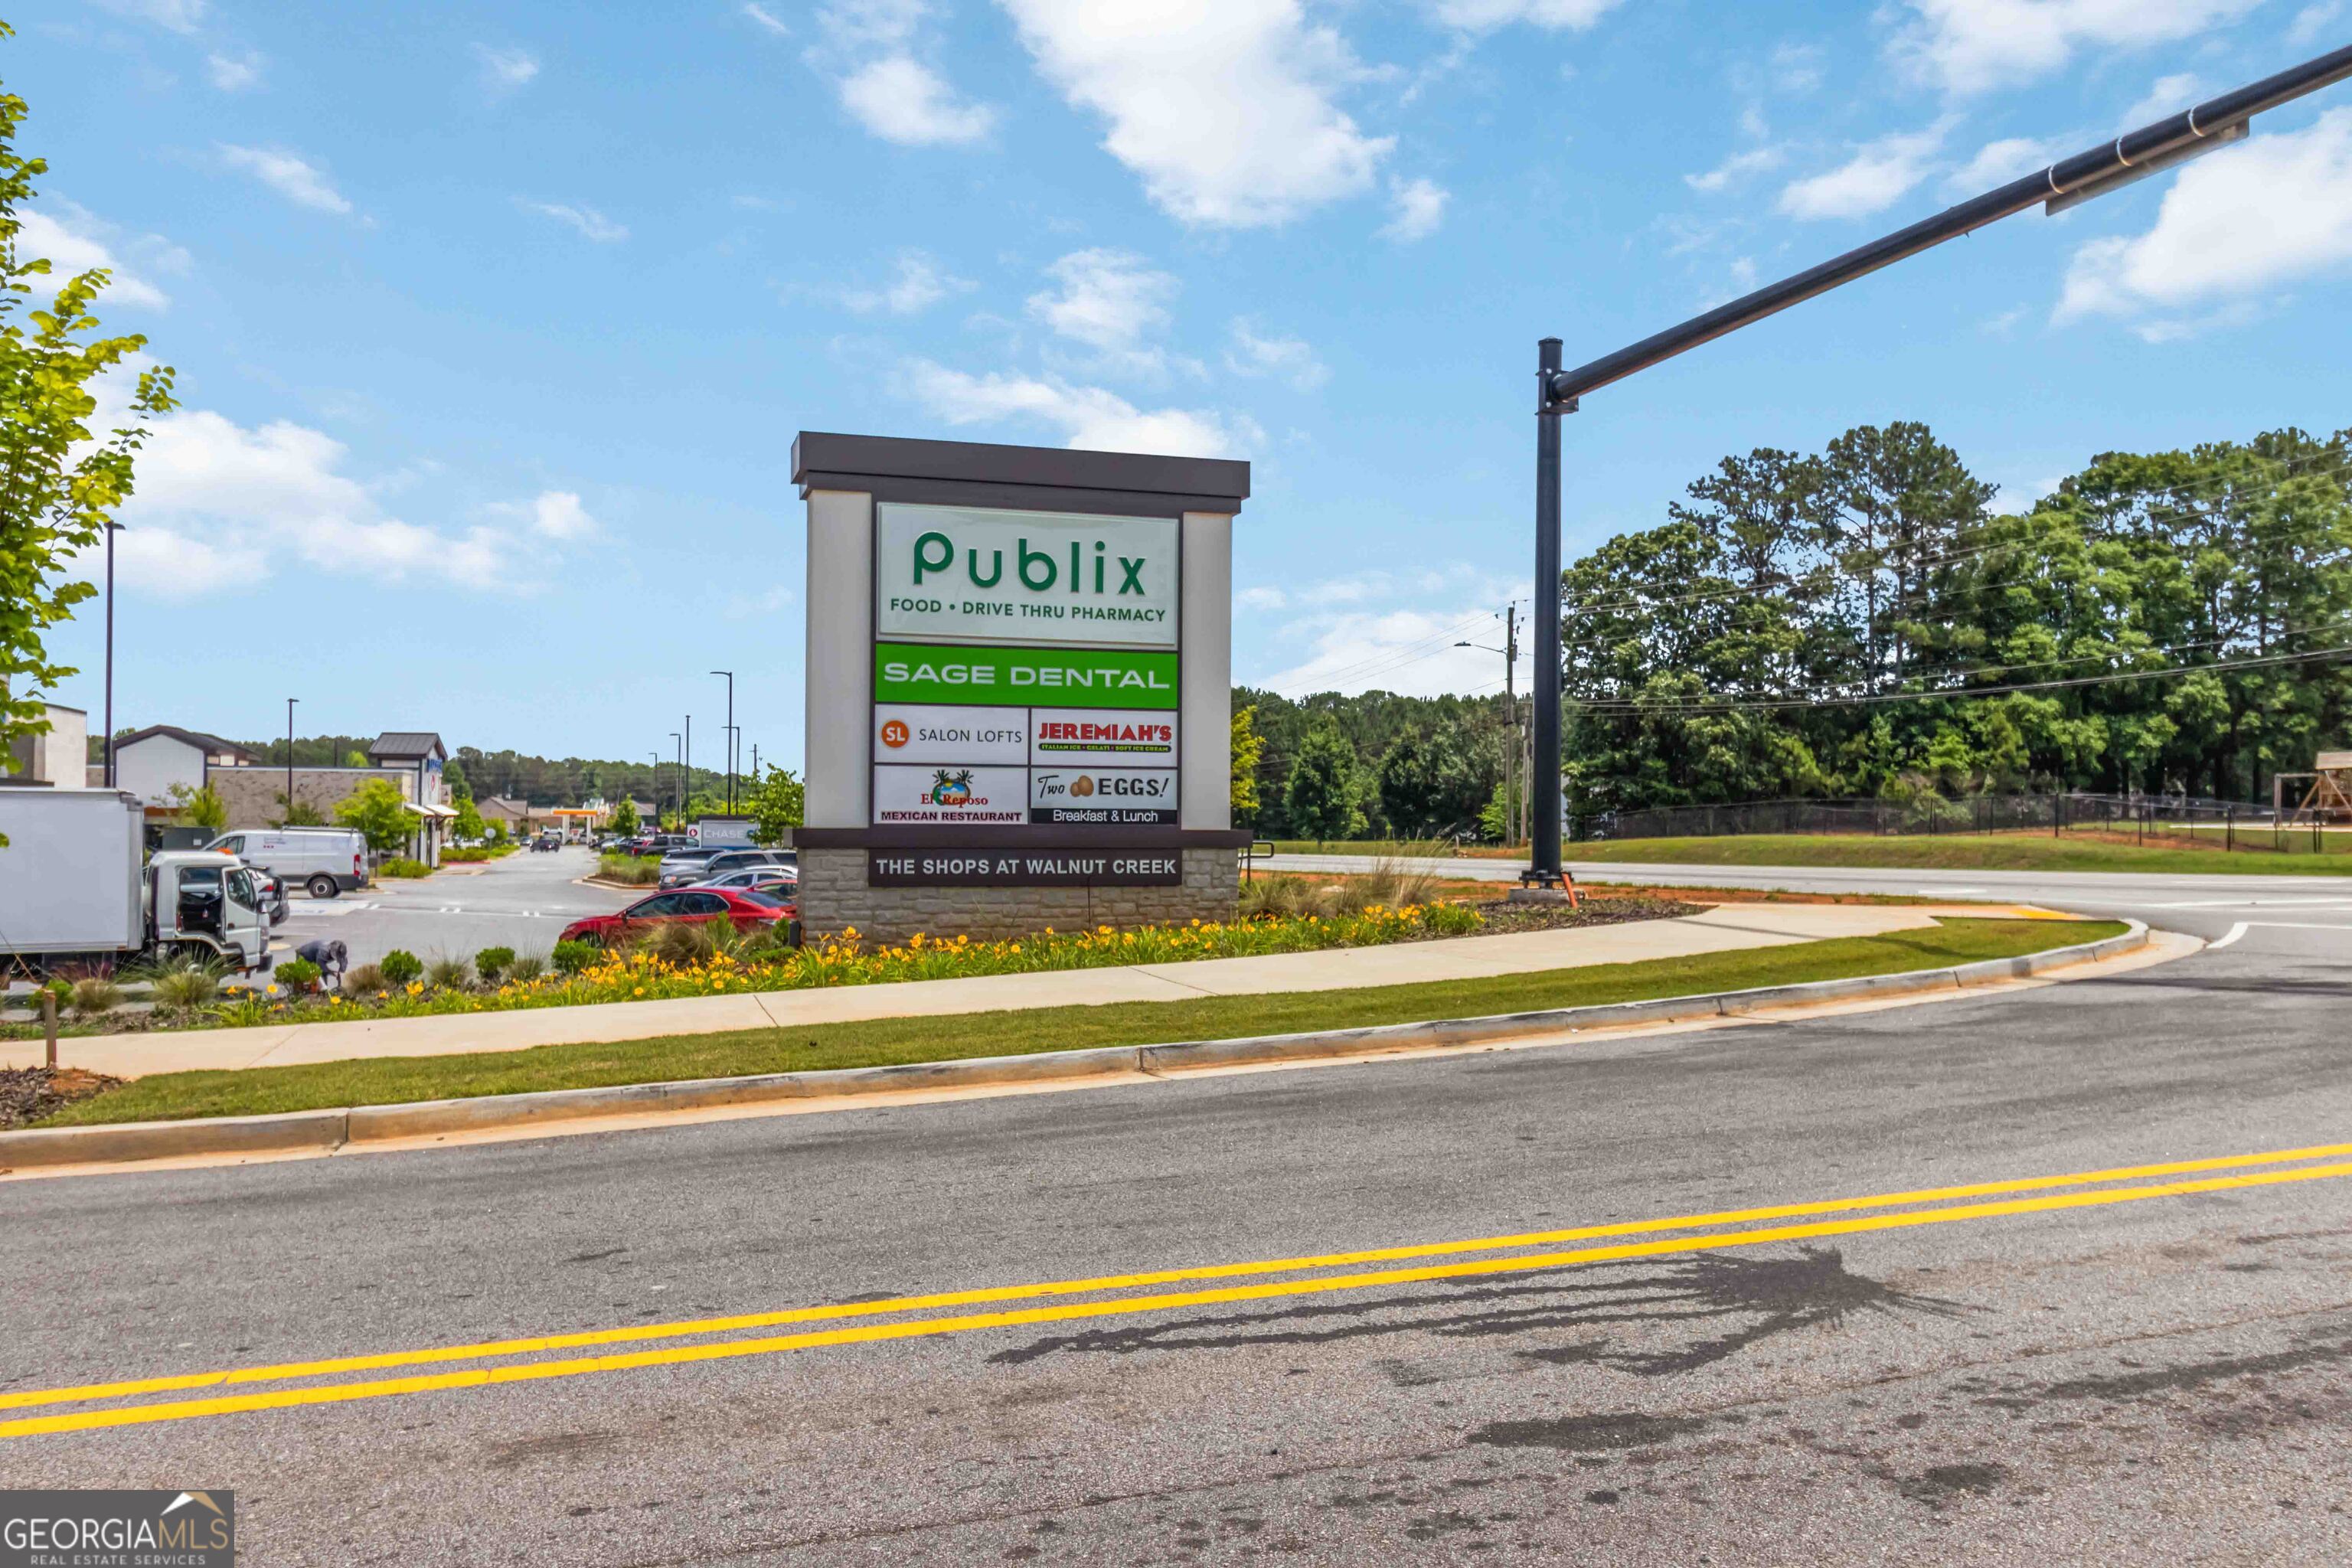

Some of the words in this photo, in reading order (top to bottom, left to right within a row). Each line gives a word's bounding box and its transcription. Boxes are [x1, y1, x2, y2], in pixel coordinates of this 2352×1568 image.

[913, 531, 1146, 596] Publix
[890, 598, 942, 612] FOOD
[962, 602, 1014, 616] DRIVE
[1020, 604, 1065, 618] THRU
[1071, 607, 1166, 622] PHARMACY
[884, 663, 995, 684] SAGE
[1011, 667, 1170, 688] DENTAL
[886, 727, 905, 741] SL
[919, 729, 970, 742] SALON
[977, 730, 1023, 743] LOFTS
[1039, 723, 1172, 742] JEREMIAH'S
[1037, 775, 1065, 799] Two
[1098, 778, 1169, 798] EGGS!
[921, 793, 933, 805] El
[942, 793, 988, 808] Reposo
[881, 812, 937, 822] MEXICAN
[942, 812, 1022, 822] RESTAURANT
[1054, 809, 1107, 822] Breakfast
[1111, 810, 1119, 822] &
[1123, 811, 1158, 822] Lunch
[704, 829, 744, 839] CHASE
[876, 859, 916, 875] THE
[923, 859, 990, 875] SHOPS
[995, 859, 1020, 874] AT
[1026, 859, 1106, 875] WALNUT
[1112, 859, 1177, 875] CREEK
